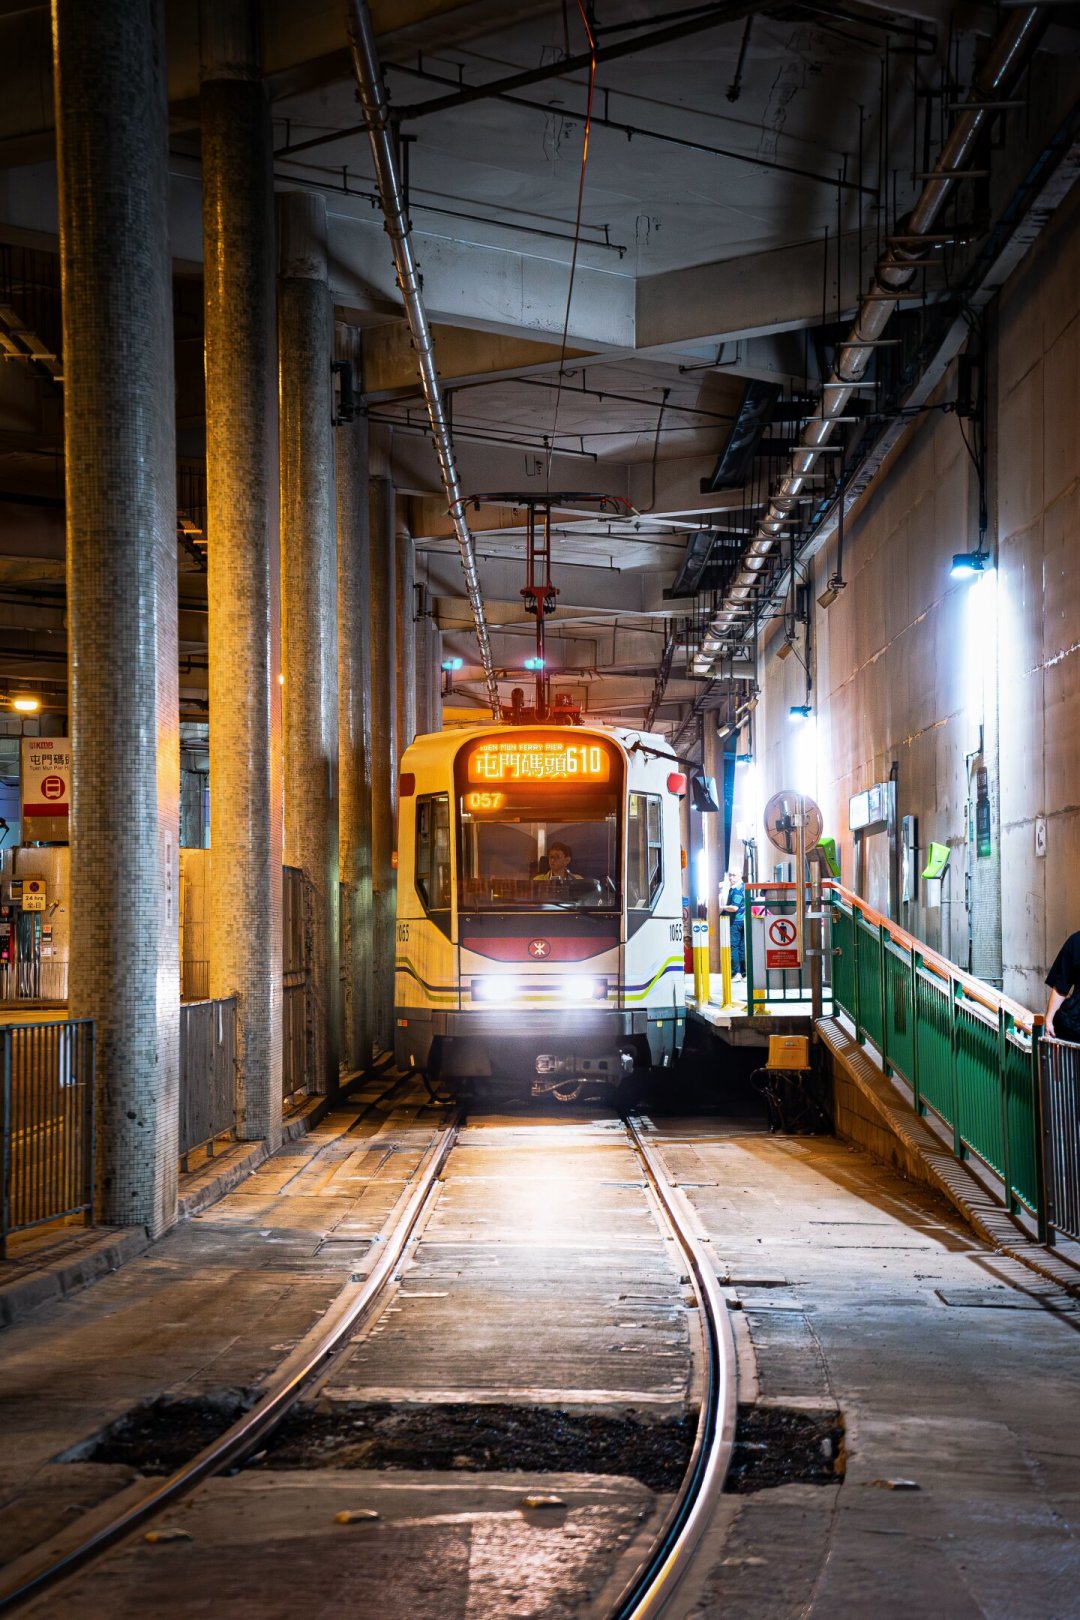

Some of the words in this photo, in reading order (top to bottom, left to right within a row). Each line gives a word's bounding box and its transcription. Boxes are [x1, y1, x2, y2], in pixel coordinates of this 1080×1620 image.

[519, 743, 542, 751] FERRY
[545, 743, 563, 751] PIER
[476, 753, 567, 778] 屯門碼頭
[566, 747, 600, 773] 610
[470, 792, 502, 808] 057
[669, 923, 683, 942] 1065
